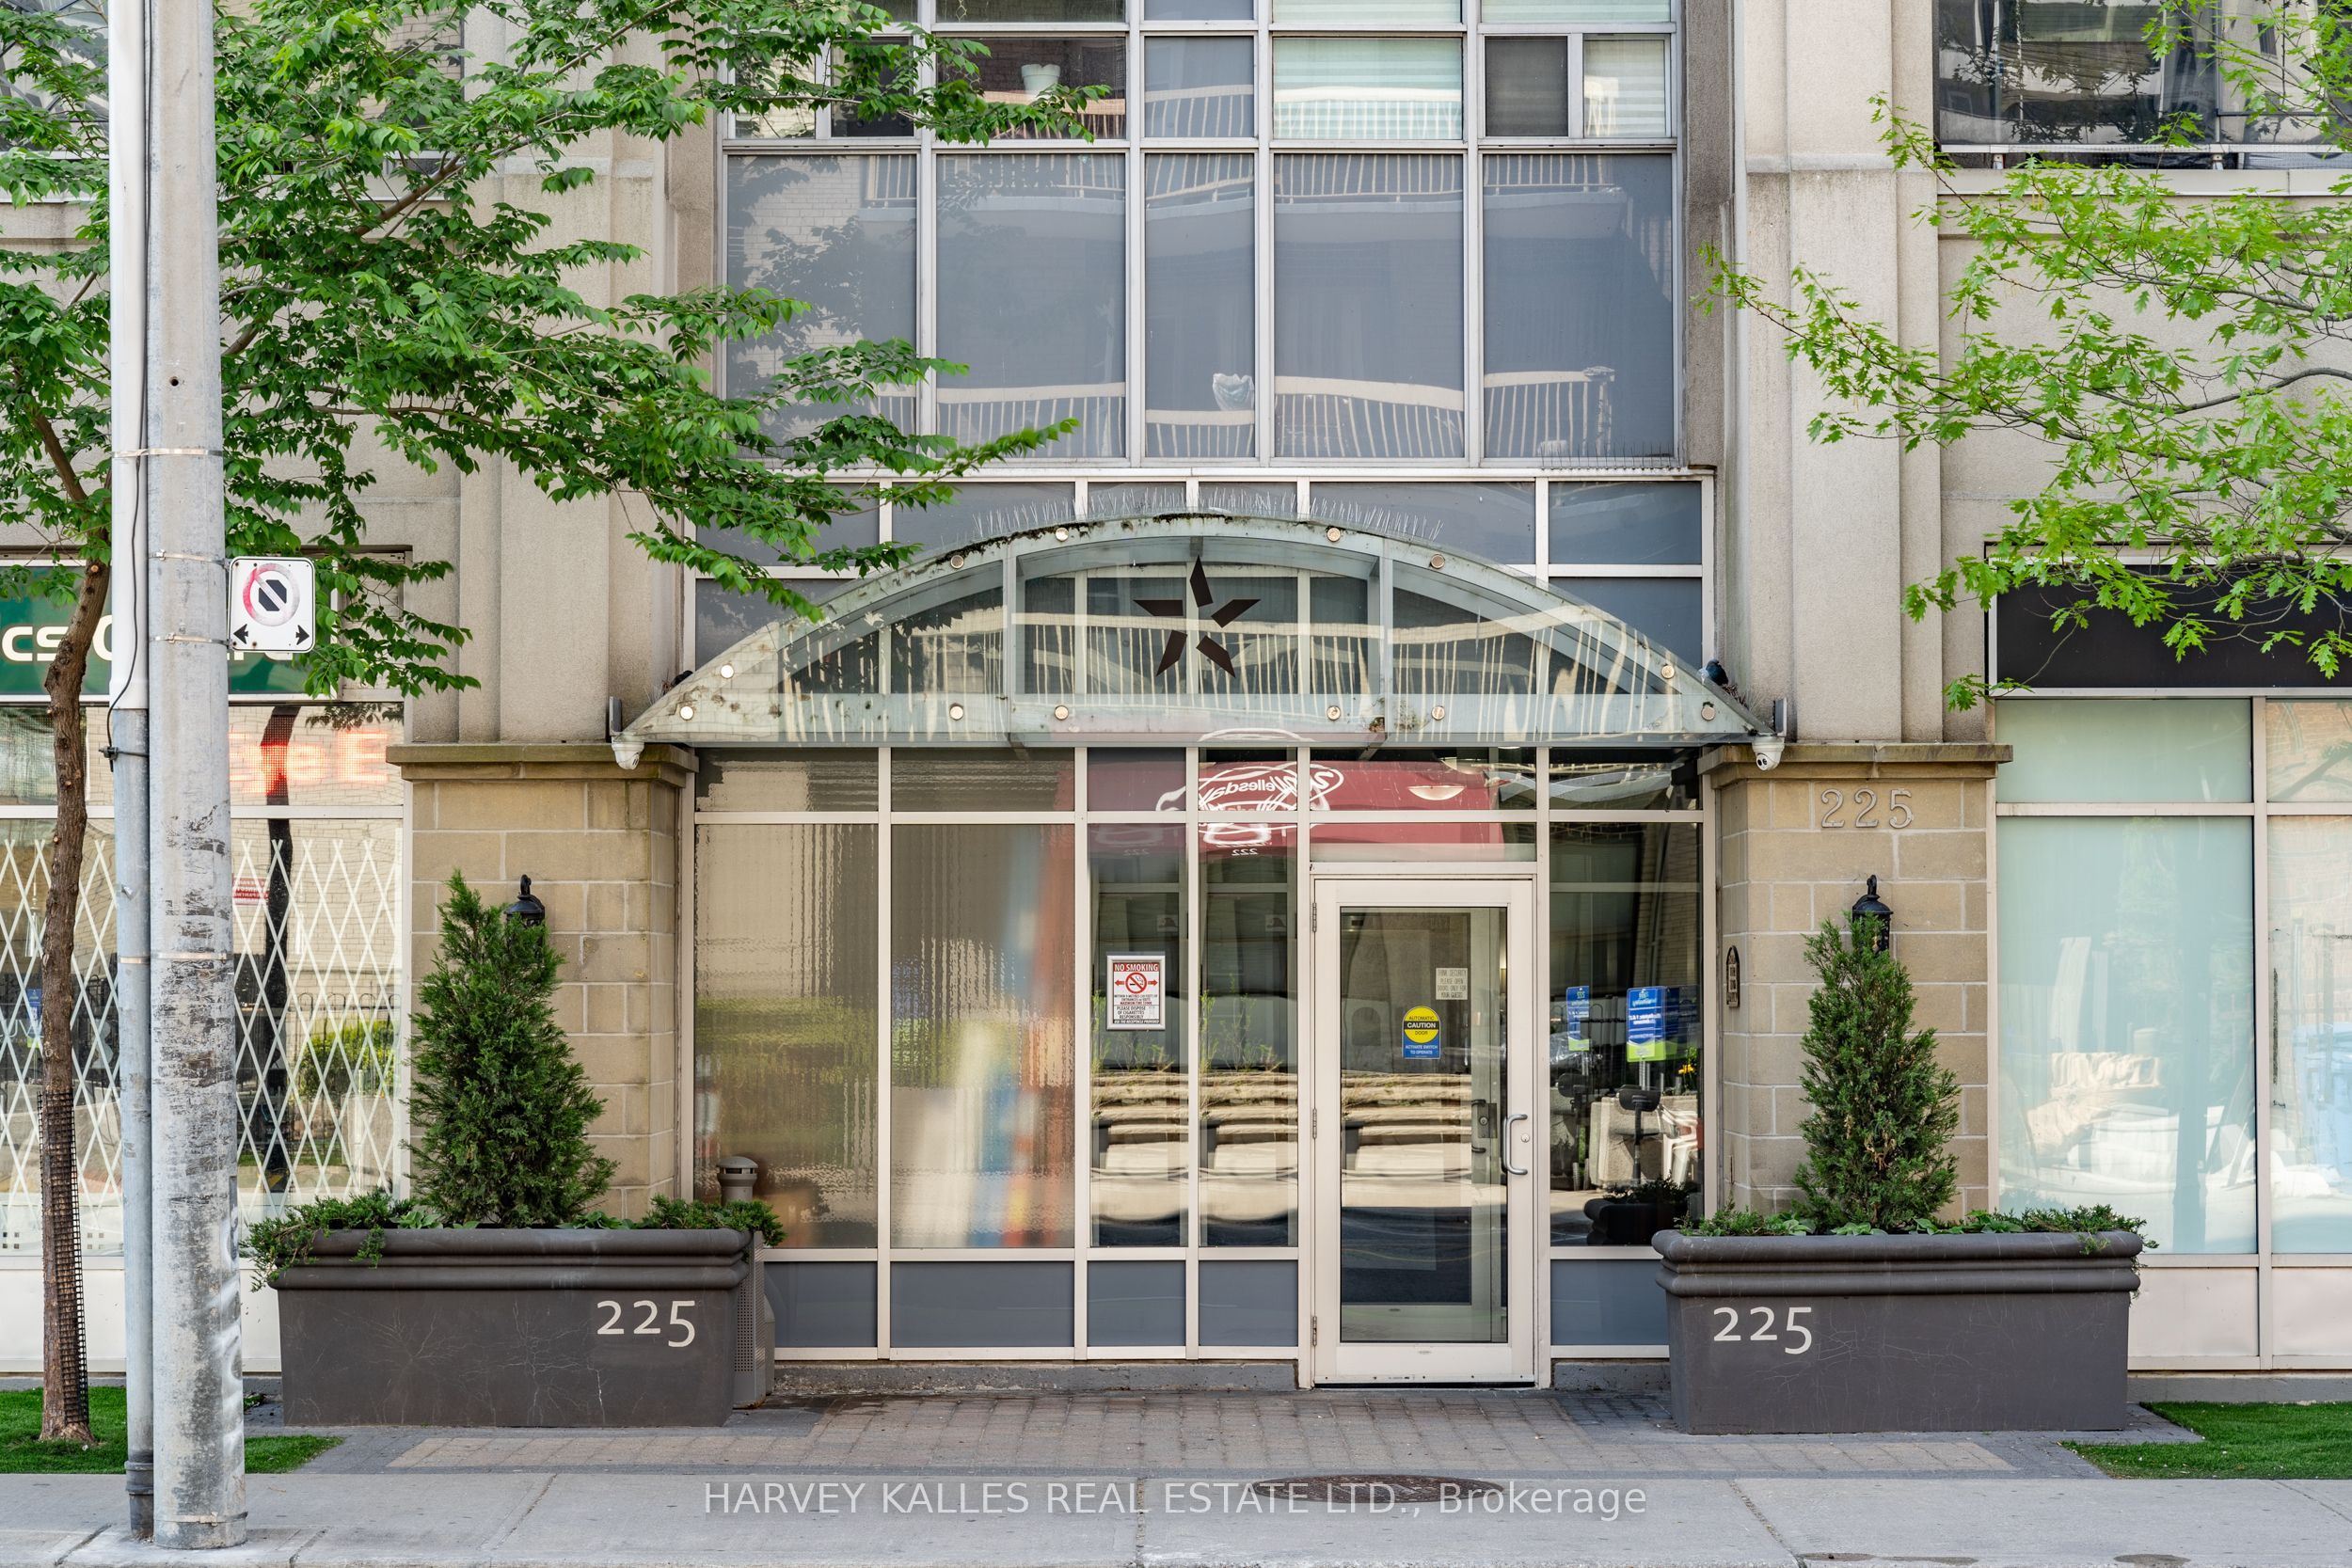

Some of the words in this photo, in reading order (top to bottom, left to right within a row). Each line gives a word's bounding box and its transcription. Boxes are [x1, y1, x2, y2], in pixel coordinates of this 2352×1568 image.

[1821, 788, 1914, 829] 225
[1114, 963, 1124, 972] NO
[1126, 963, 1158, 972] SMOKING
[596, 1300, 696, 1347] 225
[1713, 1307, 1812, 1354] 225
